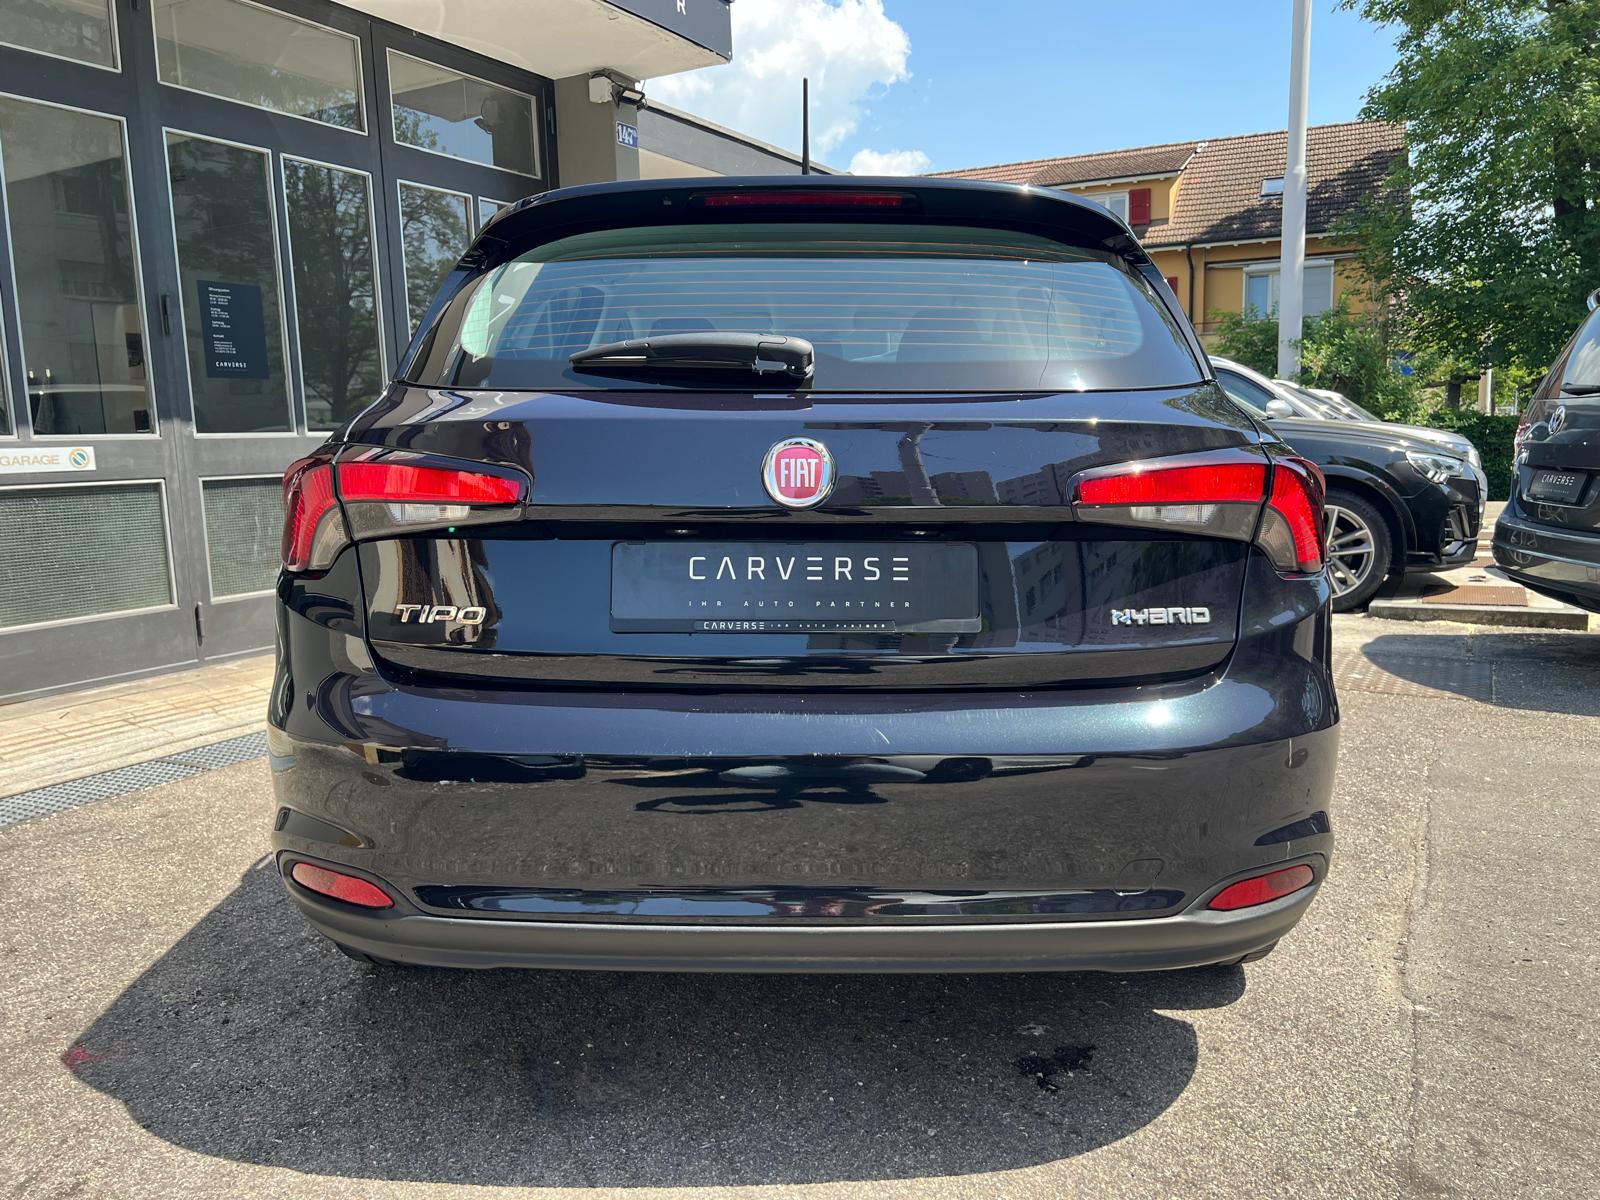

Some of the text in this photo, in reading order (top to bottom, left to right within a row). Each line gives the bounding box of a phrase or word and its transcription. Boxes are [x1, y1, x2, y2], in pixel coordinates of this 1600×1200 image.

[0, 455, 60, 466] GARAGE
[780, 458, 819, 488] FIAT
[1541, 474, 1575, 485] CARVERSE
[689, 557, 909, 581] CARVERSE
[396, 604, 487, 625] TIPO
[703, 621, 765, 630] CARVERSE
